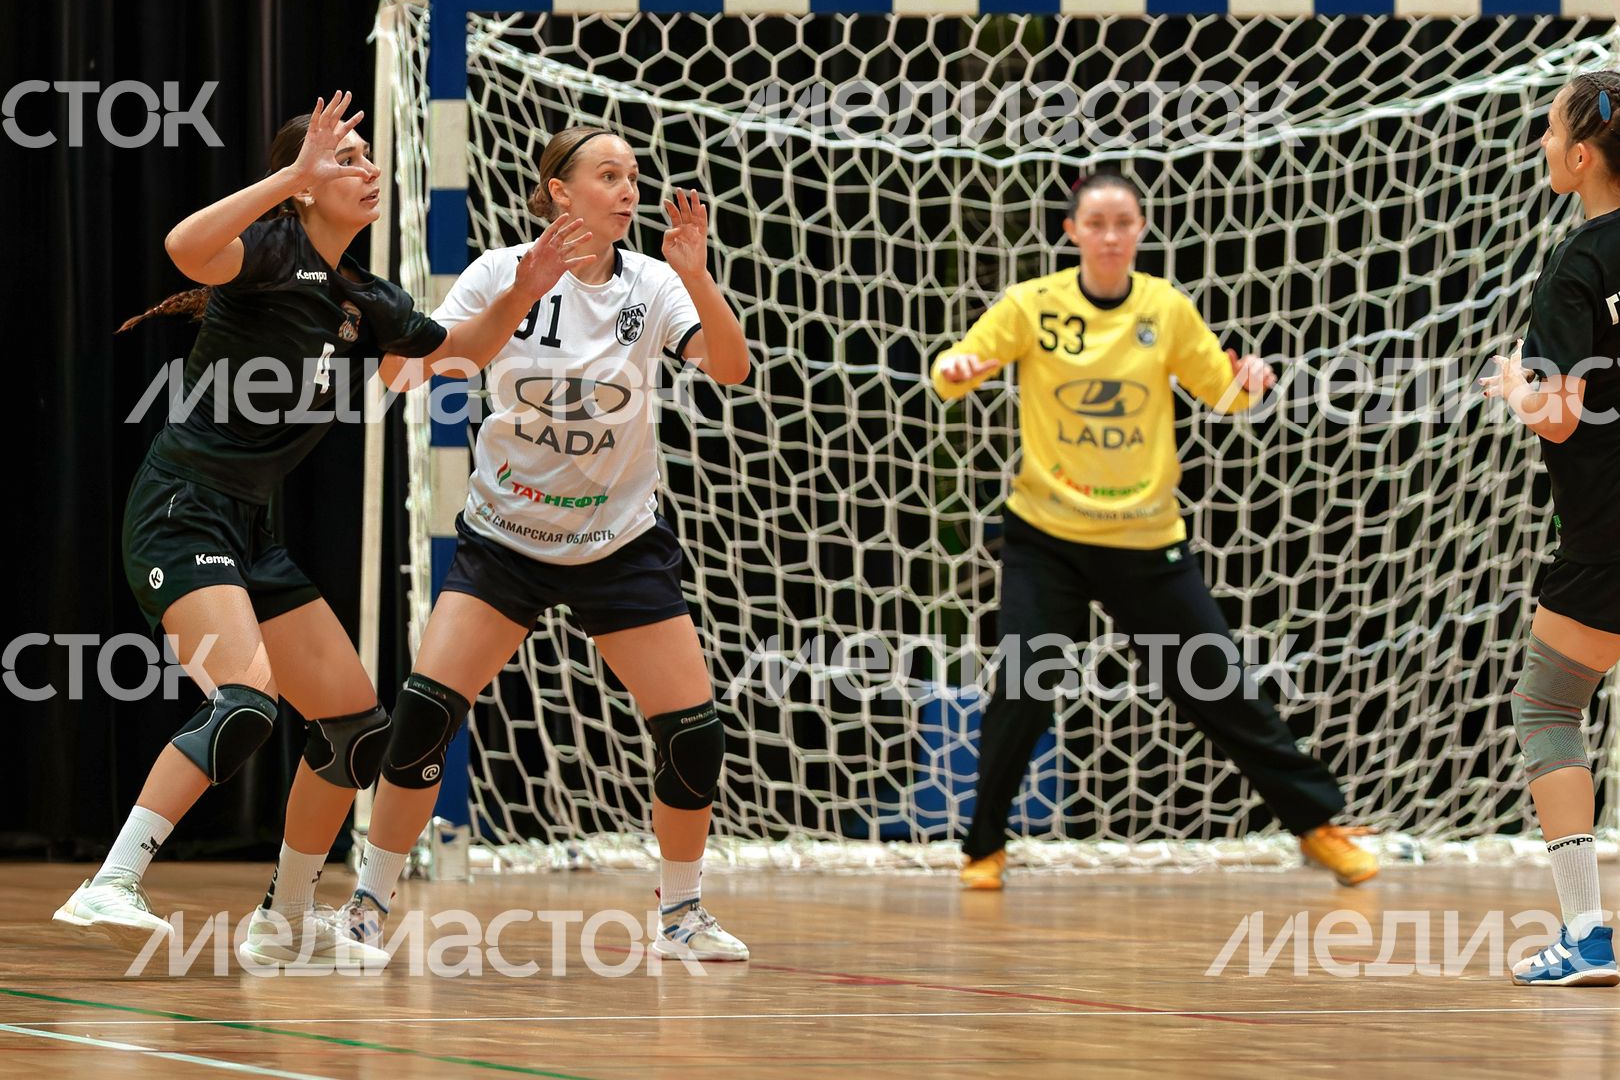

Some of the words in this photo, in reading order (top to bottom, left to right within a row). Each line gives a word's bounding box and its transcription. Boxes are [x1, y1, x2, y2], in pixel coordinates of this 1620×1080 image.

[1040, 313, 1086, 355] 53
[314, 342, 335, 393] 4
[514, 416, 616, 456] LADA
[1057, 419, 1144, 449] LADA
[492, 515, 564, 543] САМАРСКАЯ
[195, 554, 236, 567] Kempa
[1547, 836, 1593, 853] Kempa
